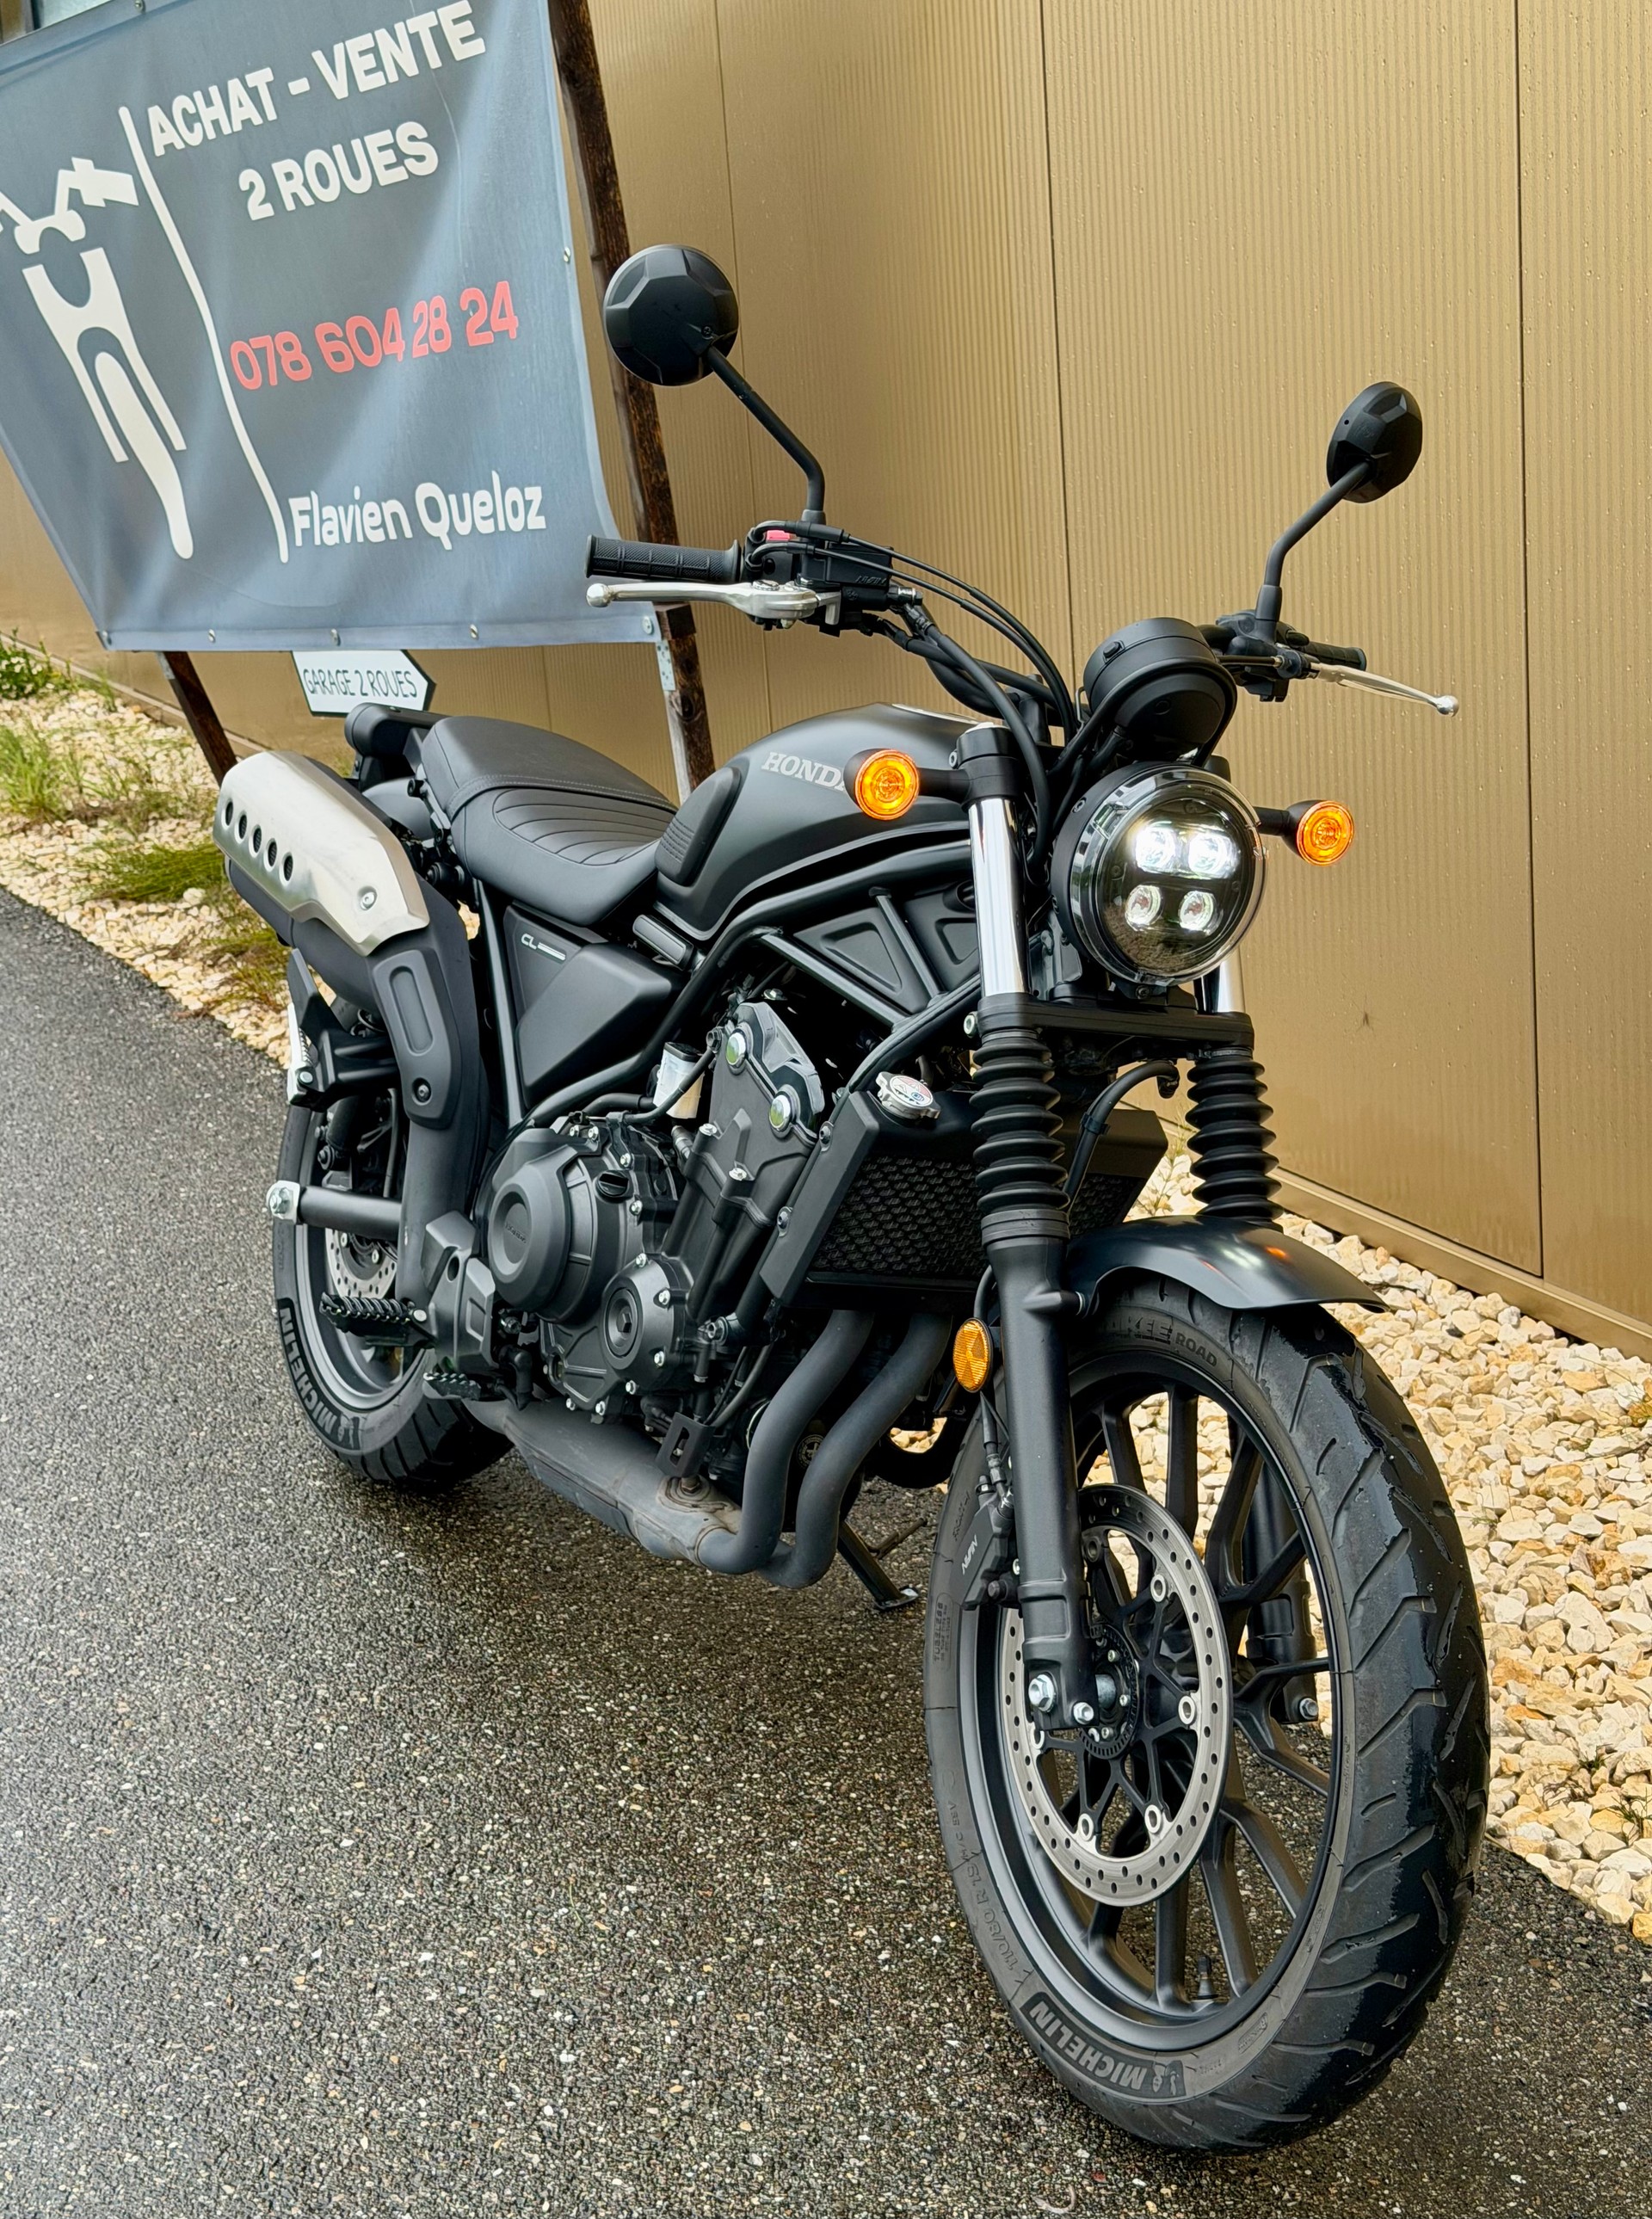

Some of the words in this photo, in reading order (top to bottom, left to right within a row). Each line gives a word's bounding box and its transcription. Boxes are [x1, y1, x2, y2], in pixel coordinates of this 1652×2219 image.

[149, 69, 275, 157] ACHAT
[289, 79, 309, 95] -
[311, 1, 485, 100] VENTE
[239, 170, 274, 220] 2
[274, 122, 439, 212] ROUES
[229, 330, 312, 390] 078
[315, 307, 404, 373] 604
[412, 296, 451, 357] 28
[459, 280, 519, 346] 24
[287, 487, 412, 548] Flavien
[415, 471, 546, 550] Queloz
[303, 668, 355, 696] GARAGE
[354, 669, 368, 696] 2
[366, 669, 417, 698] ROUES
[279, 1306, 338, 1437] MICHELIN
[1175, 1332, 1217, 1367] ROAD
[1029, 2000, 1148, 2091] MICHELIN
